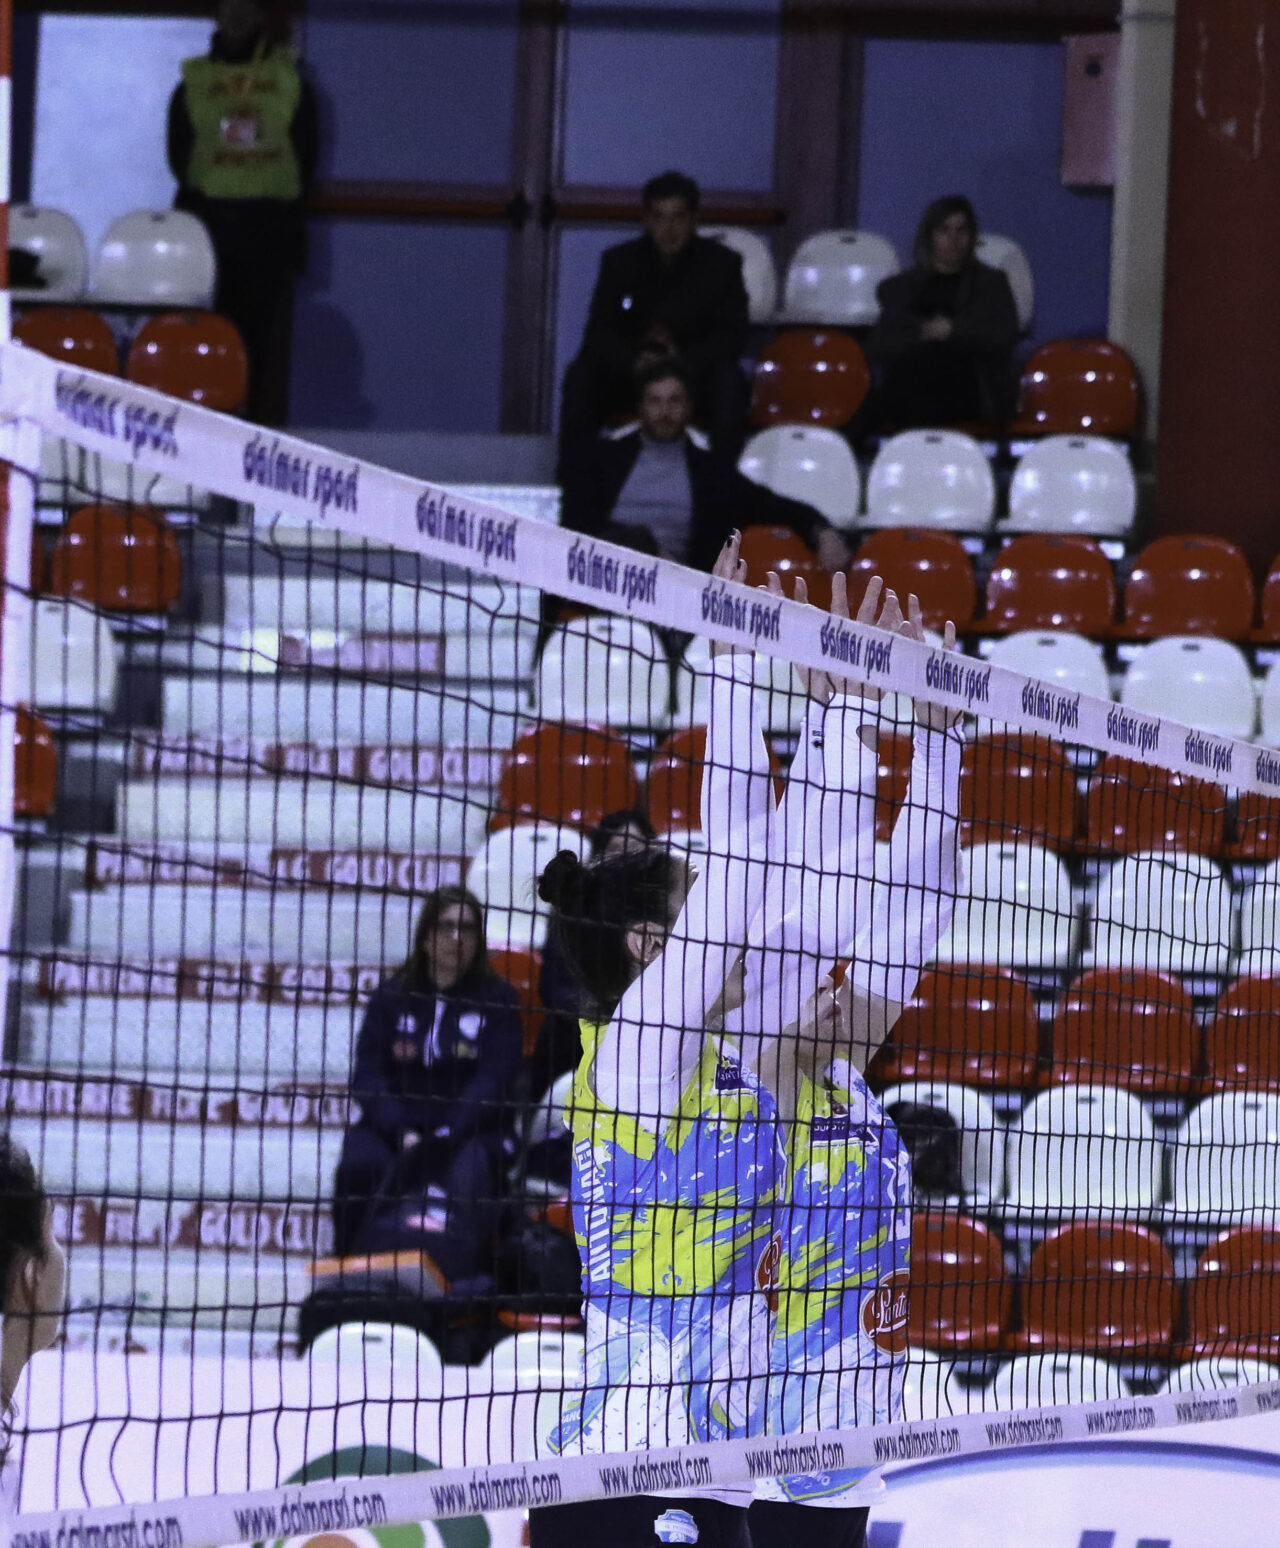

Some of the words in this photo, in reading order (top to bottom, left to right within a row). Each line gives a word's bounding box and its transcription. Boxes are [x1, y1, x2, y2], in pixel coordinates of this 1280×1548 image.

[242, 431, 311, 499] dalmar
[312, 460, 360, 520] sport
[415, 487, 475, 552] dalmar
[476, 511, 519, 570] sport
[566, 538, 618, 597] dalmar
[621, 560, 660, 612] sport
[700, 577, 748, 632] dalmar
[749, 599, 783, 647] sport
[819, 614, 862, 666] dalmar
[864, 635, 895, 680] sport
[926, 648, 964, 697] dalmar
[965, 665, 993, 709] sport
[1021, 676, 1055, 724] dalmar
[1055, 691, 1082, 735] sport
[1106, 703, 1138, 749] dalmar
[1137, 717, 1162, 758] sport
[1184, 728, 1213, 768] dalmar
[1212, 742, 1236, 778] sport
[745, 1436, 845, 1478] www.dalmarsrl.com
[873, 1423, 961, 1463] www.dalmarsrl.com
[985, 1413, 1063, 1446] www.dalmarsrl.com
[430, 1467, 562, 1514] www.dalmarsrl.com
[599, 1451, 713, 1497] www.dalmarsrl.com
[233, 1486, 389, 1541] www.dalmarsrl.com
